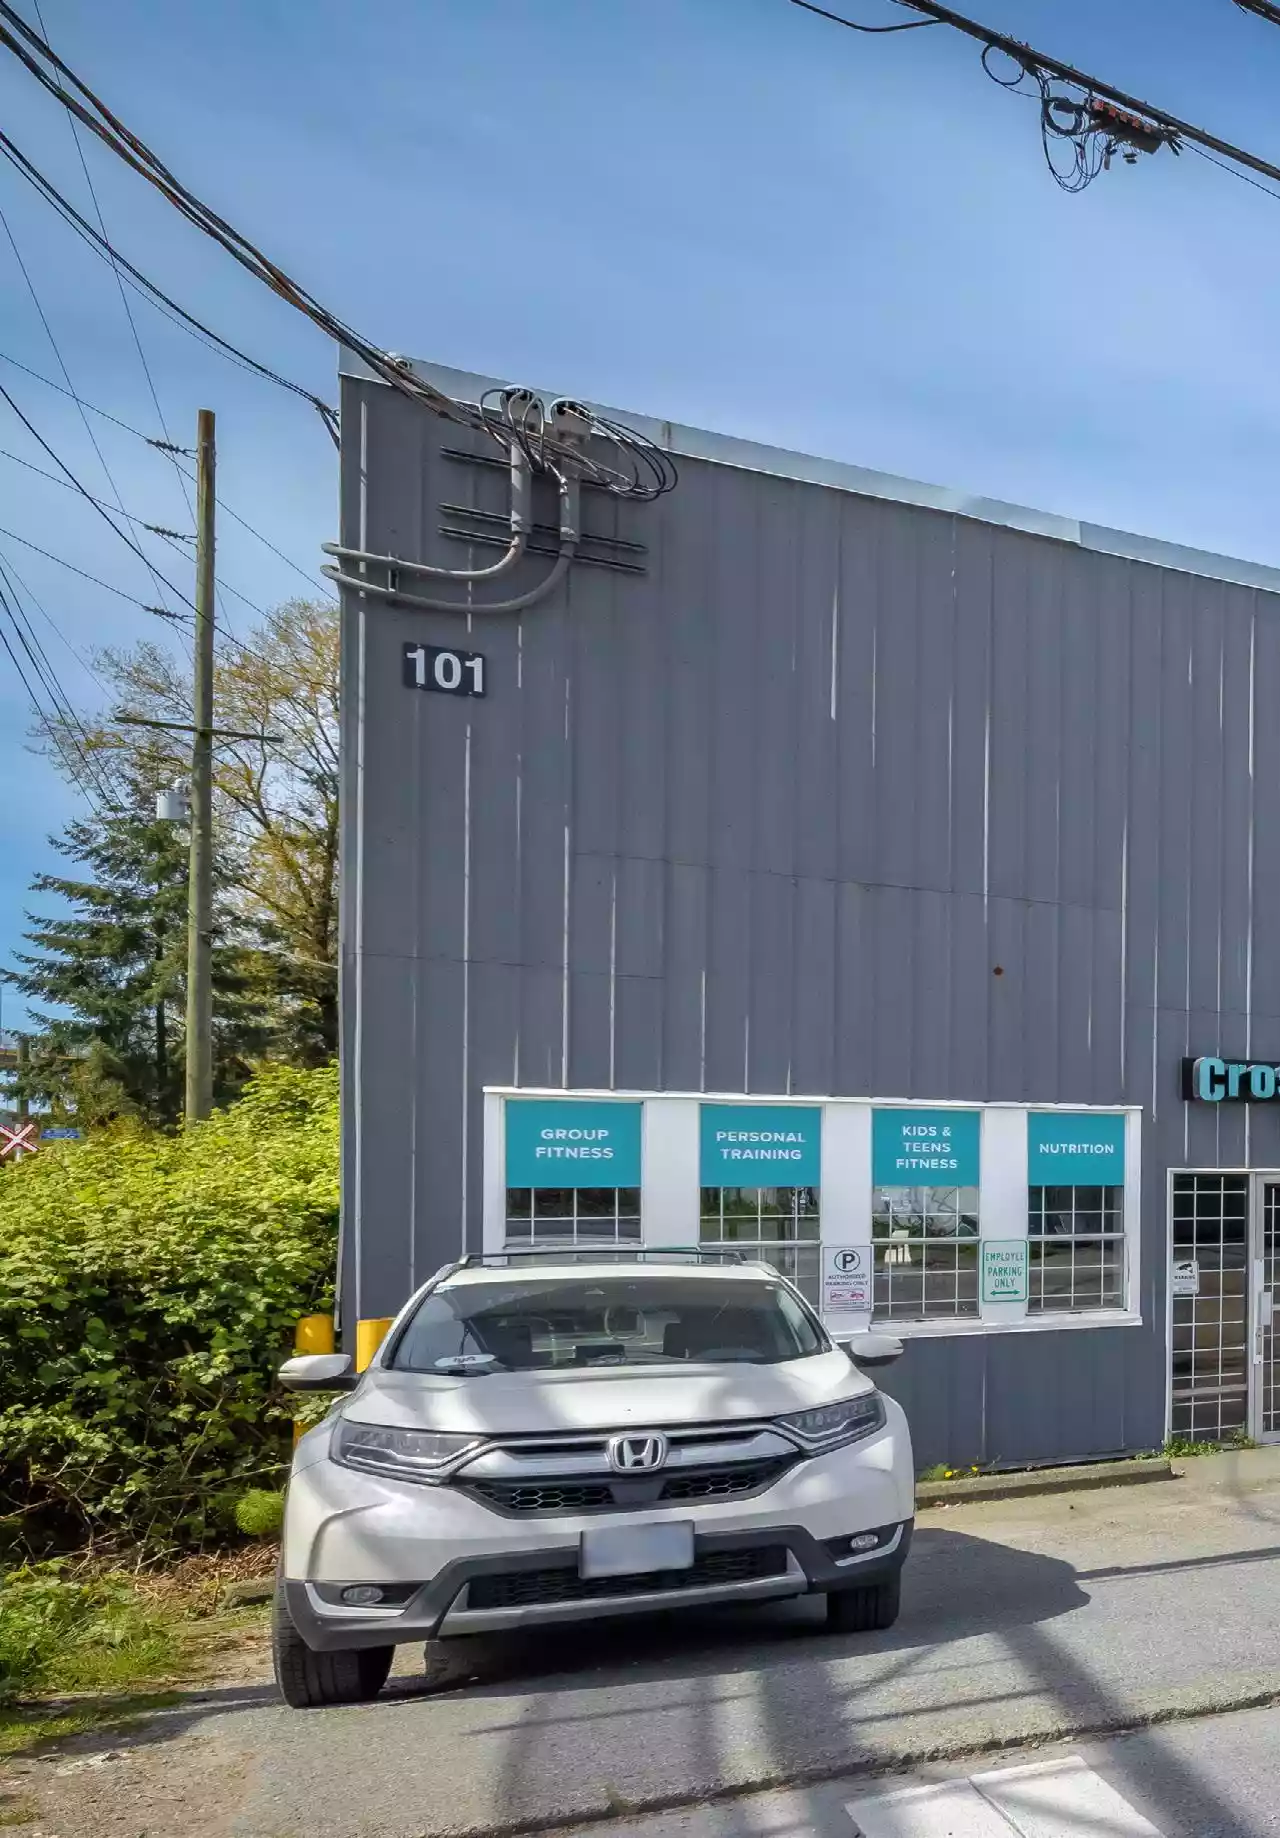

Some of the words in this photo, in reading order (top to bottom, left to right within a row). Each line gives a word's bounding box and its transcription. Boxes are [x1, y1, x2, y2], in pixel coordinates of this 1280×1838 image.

[406, 648, 483, 693] 101
[540, 1128, 609, 1141] GROUP
[716, 1131, 806, 1143] PERSONAL
[902, 1126, 937, 1137] KIDS
[942, 1126, 952, 1137] &
[535, 1146, 614, 1159] FITNESS
[903, 1142, 951, 1153] TEENS
[1039, 1143, 1114, 1154] NUTRITION
[720, 1148, 802, 1160] TRAINING
[896, 1158, 958, 1169] FITNESS
[842, 1253, 856, 1269] P
[985, 1252, 1025, 1261] EMPLOYEE
[988, 1266, 1022, 1276] PARKING
[994, 1277, 1015, 1288] ONLY
